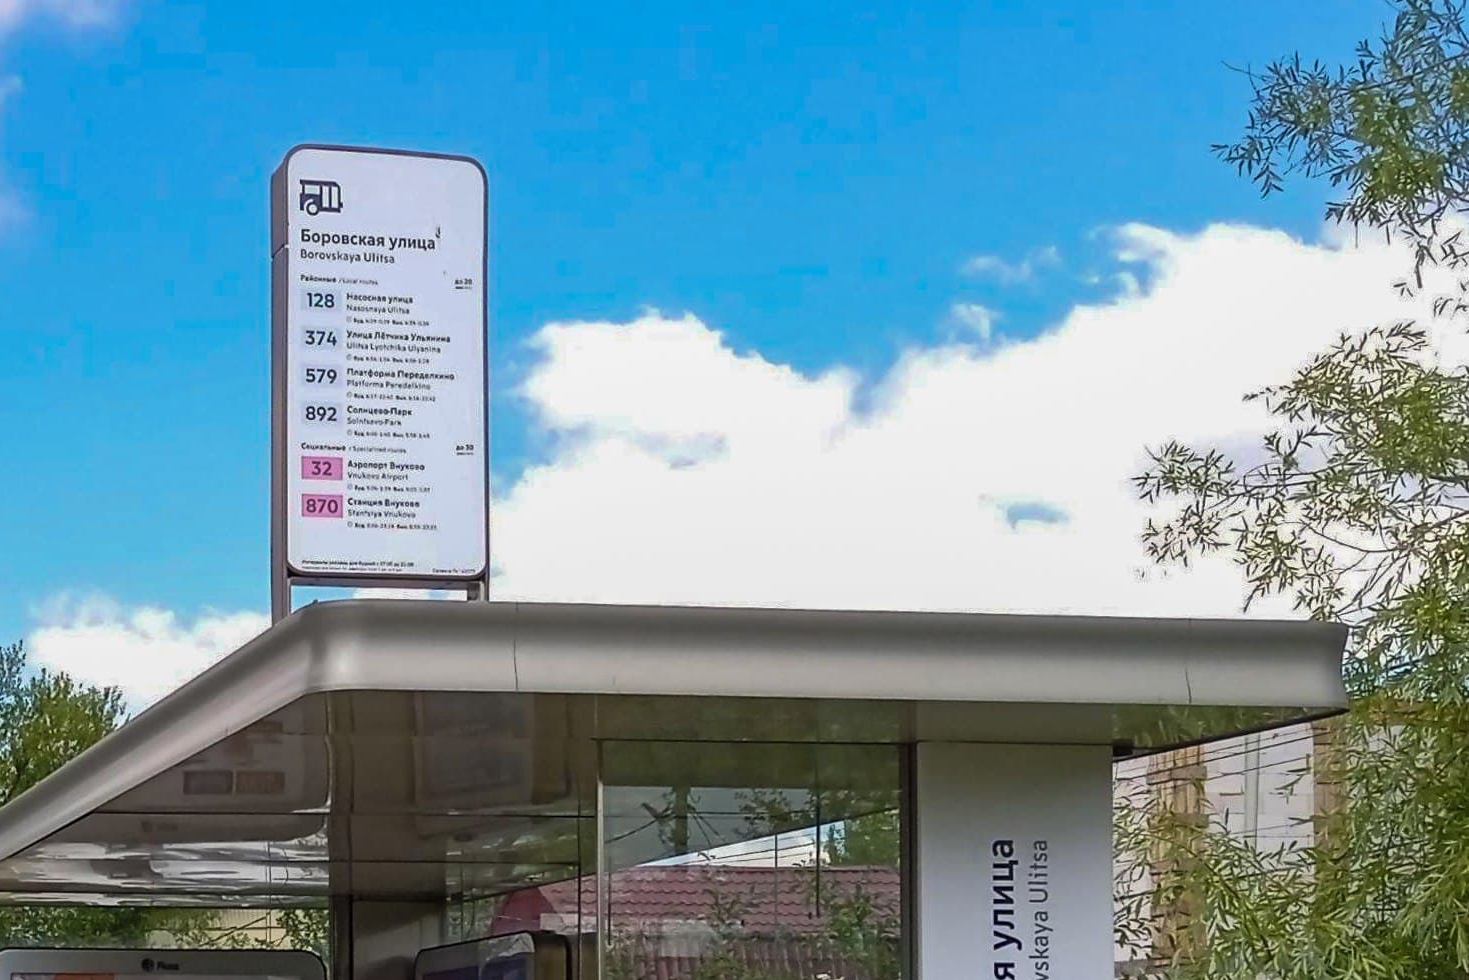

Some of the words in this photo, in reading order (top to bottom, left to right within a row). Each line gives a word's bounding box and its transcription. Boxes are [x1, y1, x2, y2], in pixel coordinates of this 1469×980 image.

[300, 228, 385, 247] Боровская
[388, 236, 435, 251] улица
[300, 249, 361, 263] Borovskaya
[364, 251, 395, 264] Ulitsa
[306, 292, 335, 308] 128
[346, 292, 386, 302] Насосная
[388, 296, 413, 304] улица
[346, 304, 386, 314] Nasosnaya
[387, 305, 410, 315] Ulitsa
[305, 330, 337, 347] 374
[346, 330, 373, 340] Улица
[346, 342, 369, 351] Ulitsa
[305, 368, 337, 384] 579
[346, 368, 395, 379] Платформа
[397, 370, 455, 381] Переделкино
[347, 379, 384, 388] Platforma
[305, 405, 337, 422] 892
[347, 405, 412, 416] Солнцево-Парк
[311, 461, 333, 477] 32
[347, 460, 388, 471] Аэропорт
[389, 462, 425, 473] Внуково
[347, 472, 379, 480] Vnukovo
[381, 473, 409, 482] Airport
[306, 498, 338, 514] 870
[347, 497, 383, 508] Станция
[384, 499, 420, 509] Внуково
[383, 509, 416, 519] Vnukovo
[1027, 839, 1049, 903] Ulitsa
[991, 839, 1023, 951] улица
